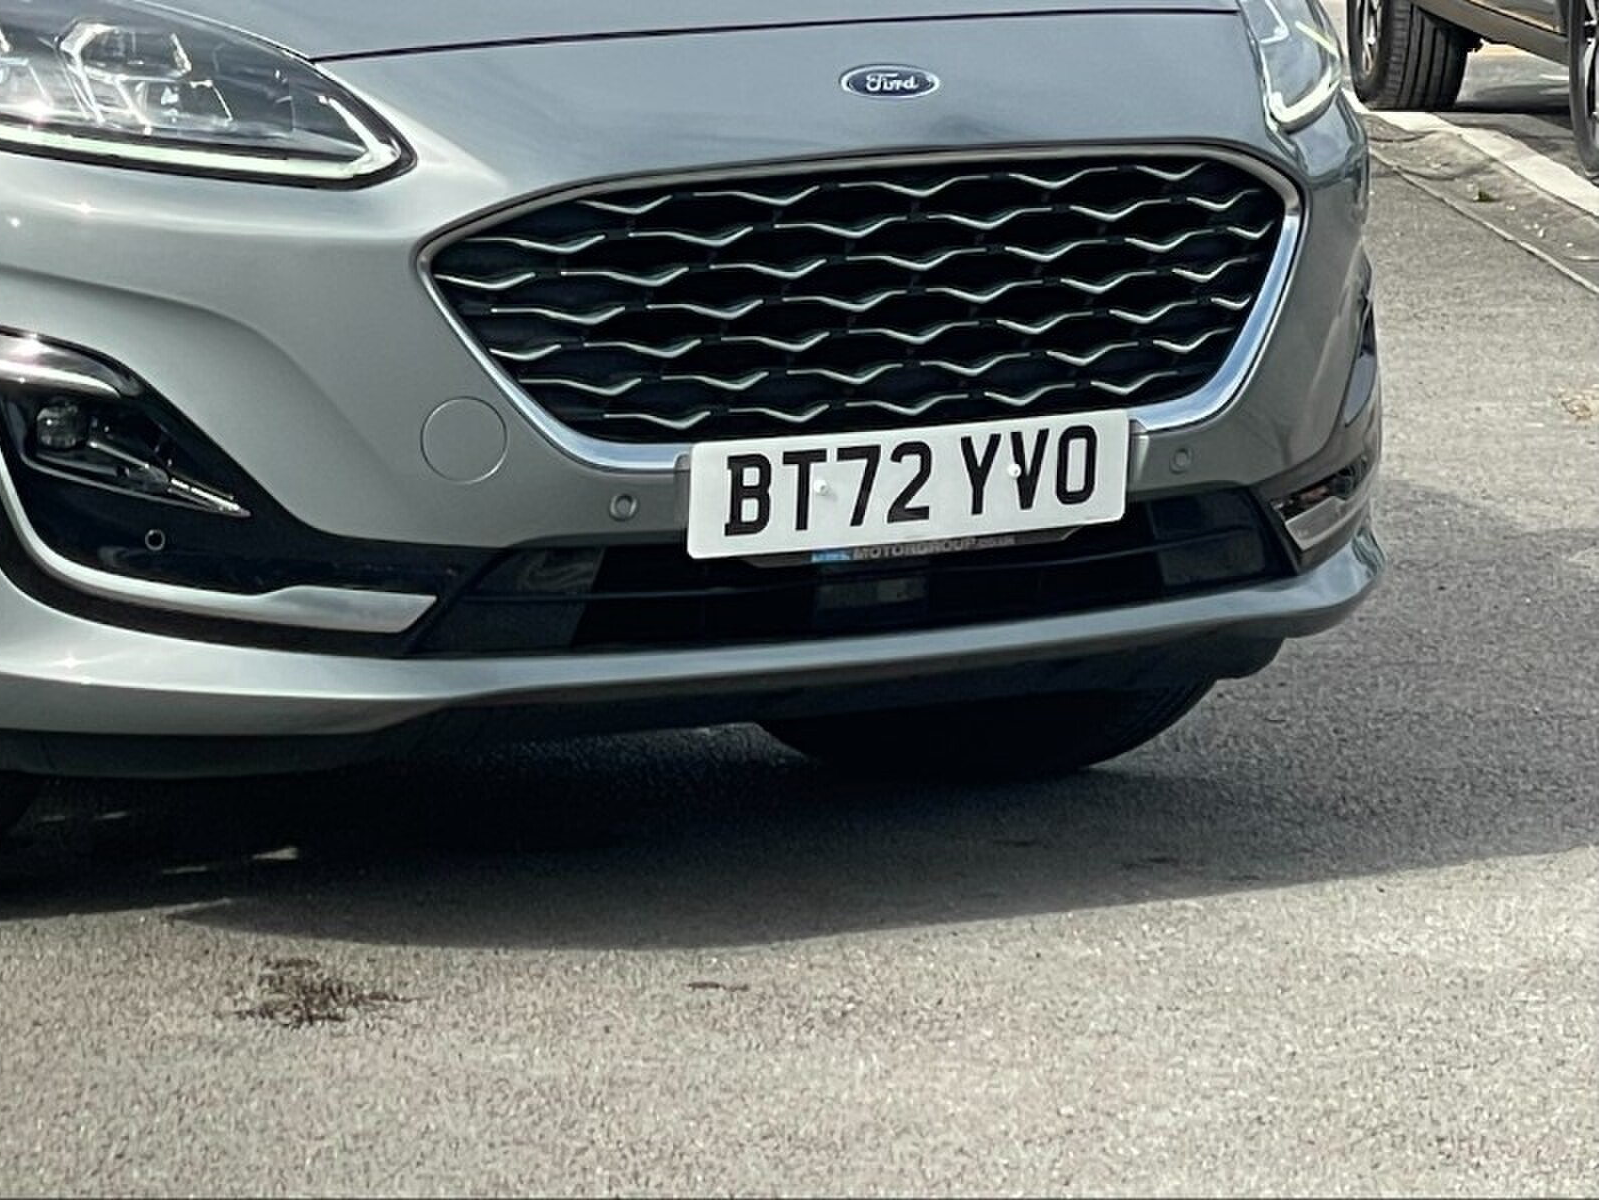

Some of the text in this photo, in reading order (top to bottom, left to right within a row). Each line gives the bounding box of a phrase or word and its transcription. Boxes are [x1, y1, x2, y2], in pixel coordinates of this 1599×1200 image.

[866, 72, 919, 92] Ford
[724, 425, 1098, 537] BT72 YVO
